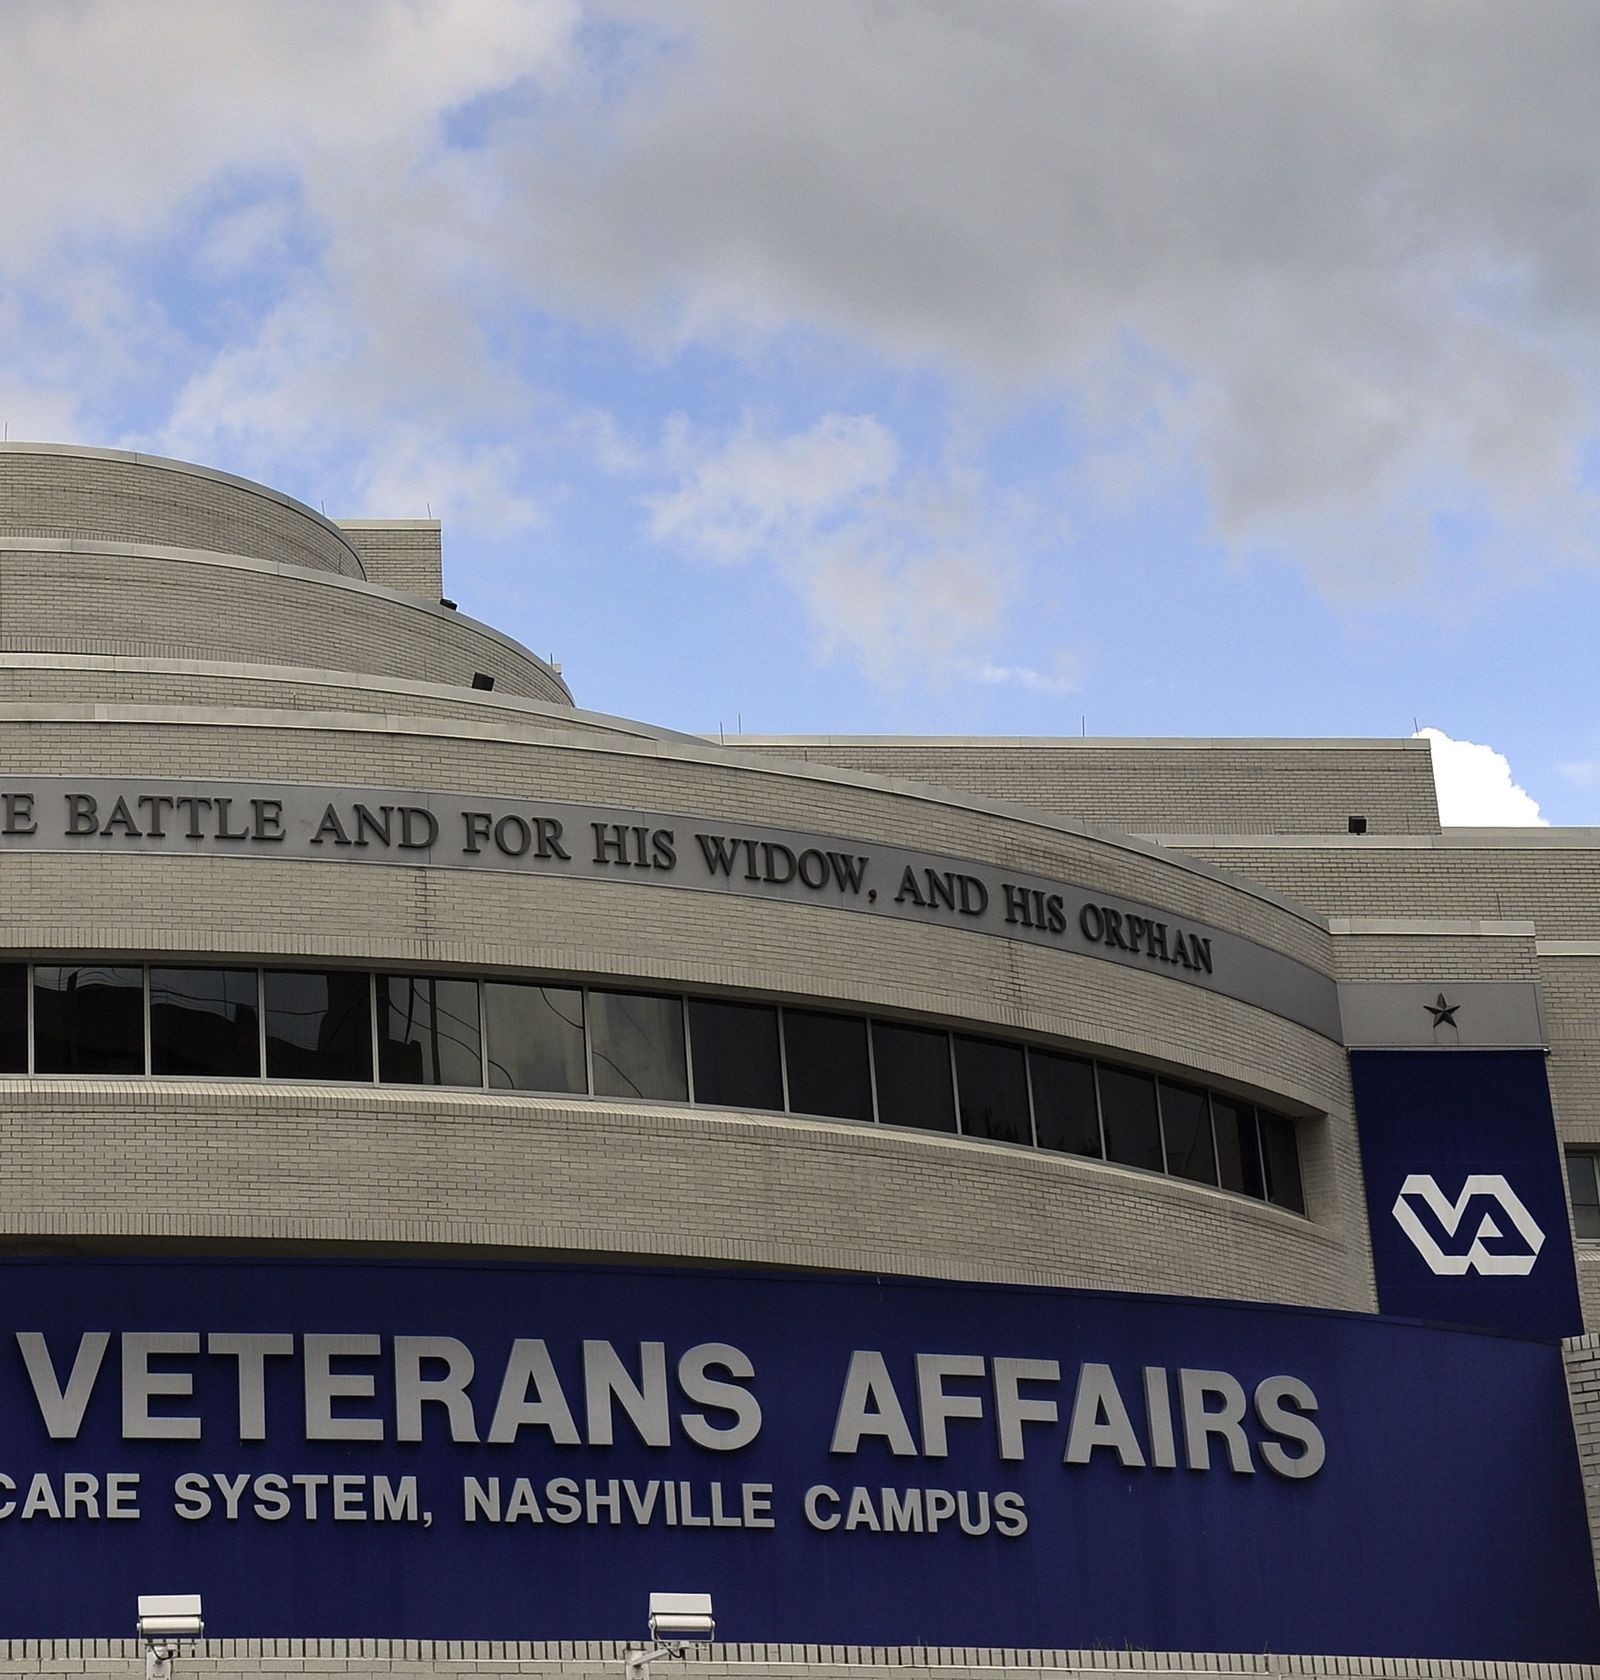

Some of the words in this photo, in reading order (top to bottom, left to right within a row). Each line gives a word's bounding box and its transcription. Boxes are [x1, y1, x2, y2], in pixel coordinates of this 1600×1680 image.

[65, 793, 286, 841] BATTLE
[310, 802, 439, 849] AND
[461, 810, 573, 860] FOR
[592, 821, 677, 870] HIS
[695, 834, 878, 903] WIDOW,
[893, 865, 989, 917] AND
[1001, 883, 1067, 934] HIS
[1079, 902, 1214, 975] ORPHAN
[1392, 1174, 1546, 1276] VA
[16, 1331, 762, 1452] VETERANS
[829, 1350, 1327, 1480] AFFAIRS
[173, 1472, 433, 1528] SYSTEM,
[463, 1476, 775, 1529] NASHVILLE
[804, 1484, 1029, 1537] CAMPUS
